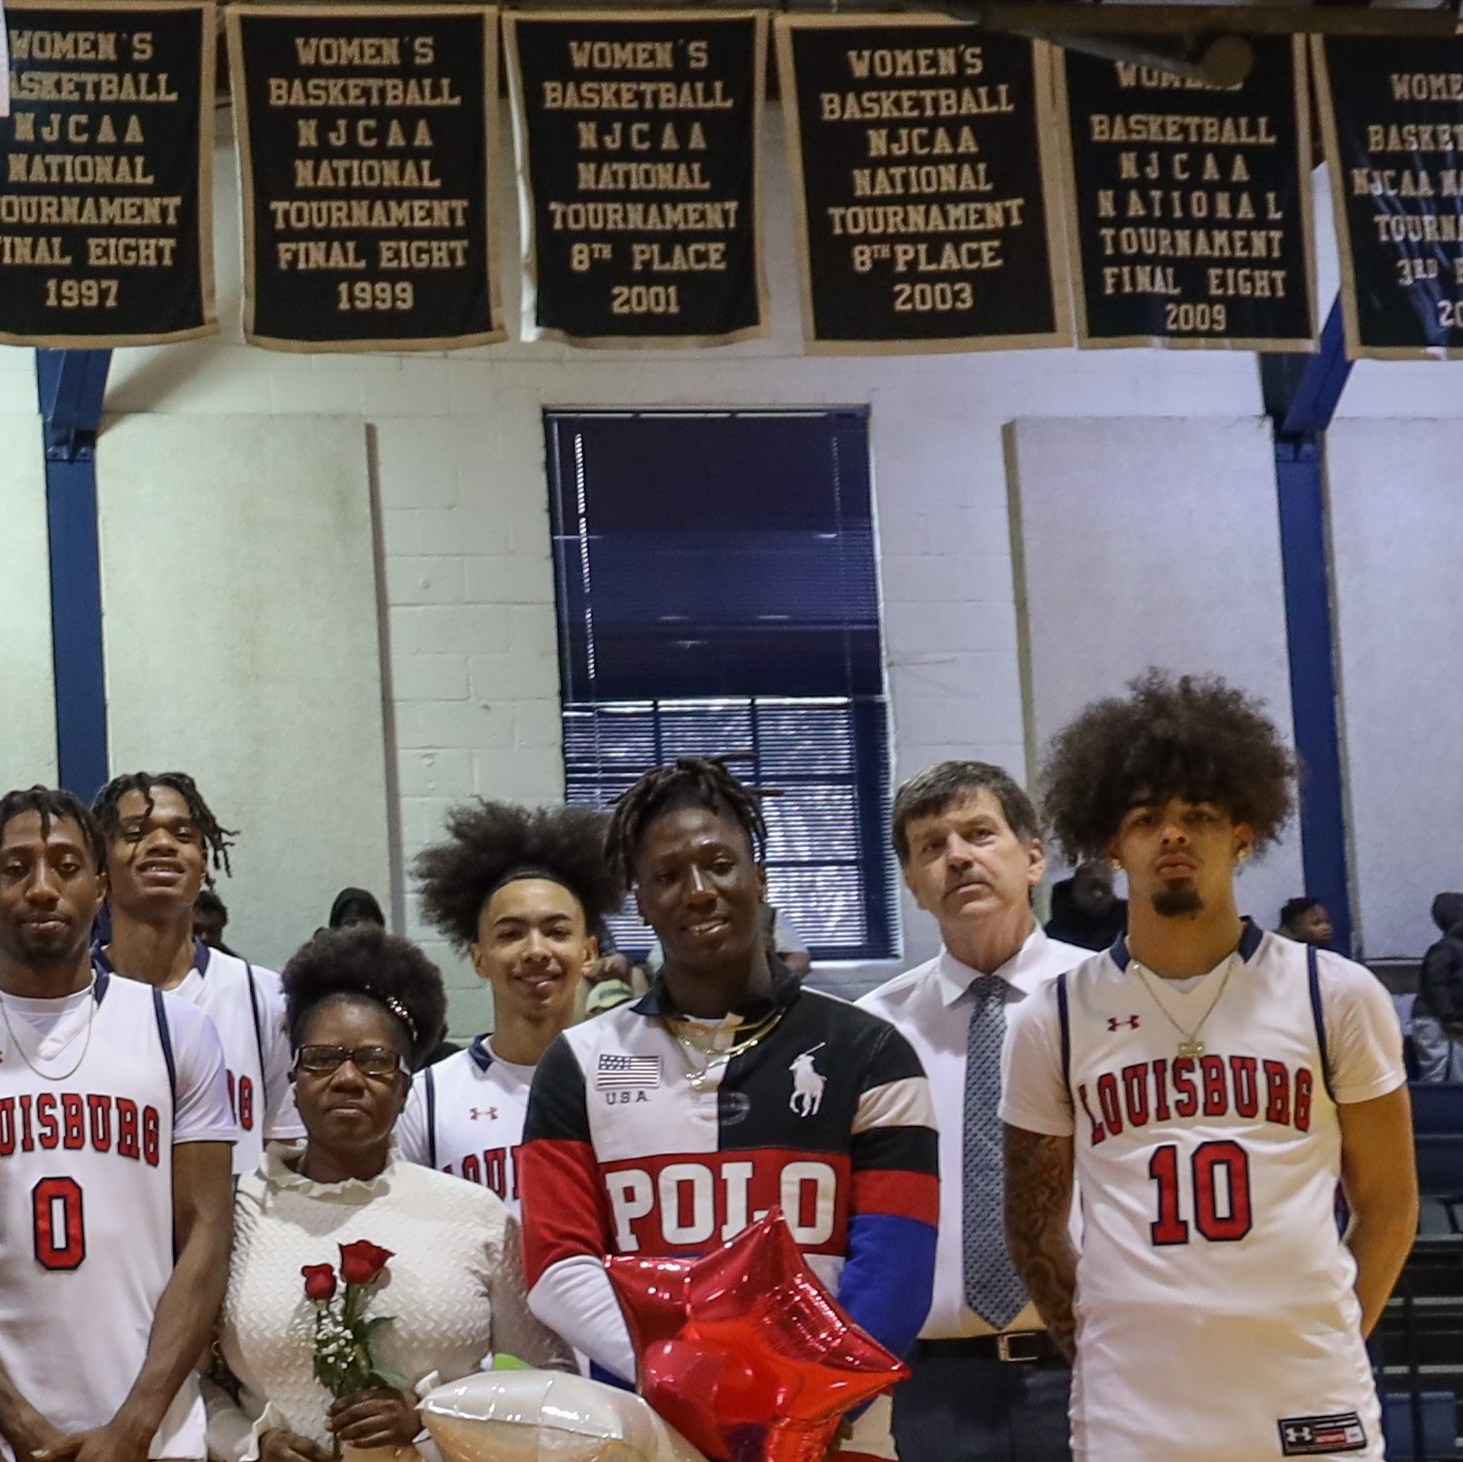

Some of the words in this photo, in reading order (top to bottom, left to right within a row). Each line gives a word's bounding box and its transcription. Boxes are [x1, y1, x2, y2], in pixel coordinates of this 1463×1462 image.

[847, 46, 983, 78] WOMEN'S
[10, 71, 178, 101] ASKETBALL
[269, 78, 461, 107] BASKETBALL
[543, 82, 733, 109] BASKETBALL
[820, 85, 1015, 120] BASKETBALL
[14, 112, 144, 142] NJCAA
[298, 119, 433, 147] NJCAA
[578, 122, 707, 149] NJCAA
[866, 126, 979, 157] NJCAA
[1089, 114, 1276, 143] BASKETBALL
[8, 154, 154, 184] NATIONAL
[294, 159, 442, 188] NATIONAL
[577, 163, 711, 190] NATIONAL
[852, 163, 993, 195] NATIONAL
[1120, 152, 1250, 181] NJCAA
[1352, 168, 1435, 196] NJCAA
[270, 200, 469, 229] TOURNAMENT
[549, 202, 739, 230] TOURNAMENT
[827, 199, 1025, 234] TOURNAMENT
[1098, 190, 1283, 219] NATIONAL
[87, 238, 176, 266] EIGHT
[278, 241, 366, 269] FINAL
[380, 240, 469, 268] EIGHT
[570, 244, 612, 271] 8TH
[632, 243, 726, 270] PLACE
[853, 244, 891, 272] 8TH
[895, 240, 1003, 270] PLACE
[1099, 228, 1283, 258] TOURNAMENT
[45, 279, 119, 307] 1997
[337, 282, 414, 311] 1999
[1103, 267, 1181, 295] FINAL
[1208, 269, 1286, 297] EIGHT
[611, 286, 680, 314] 2001
[893, 283, 974, 311] 2003
[1165, 304, 1226, 330] 2009
[1079, 1054, 1314, 1147] LOUISBURG
[605, 1161, 838, 1252] POLO
[1149, 1140, 1251, 1246] 10
[32, 1176, 86, 1270] 0
